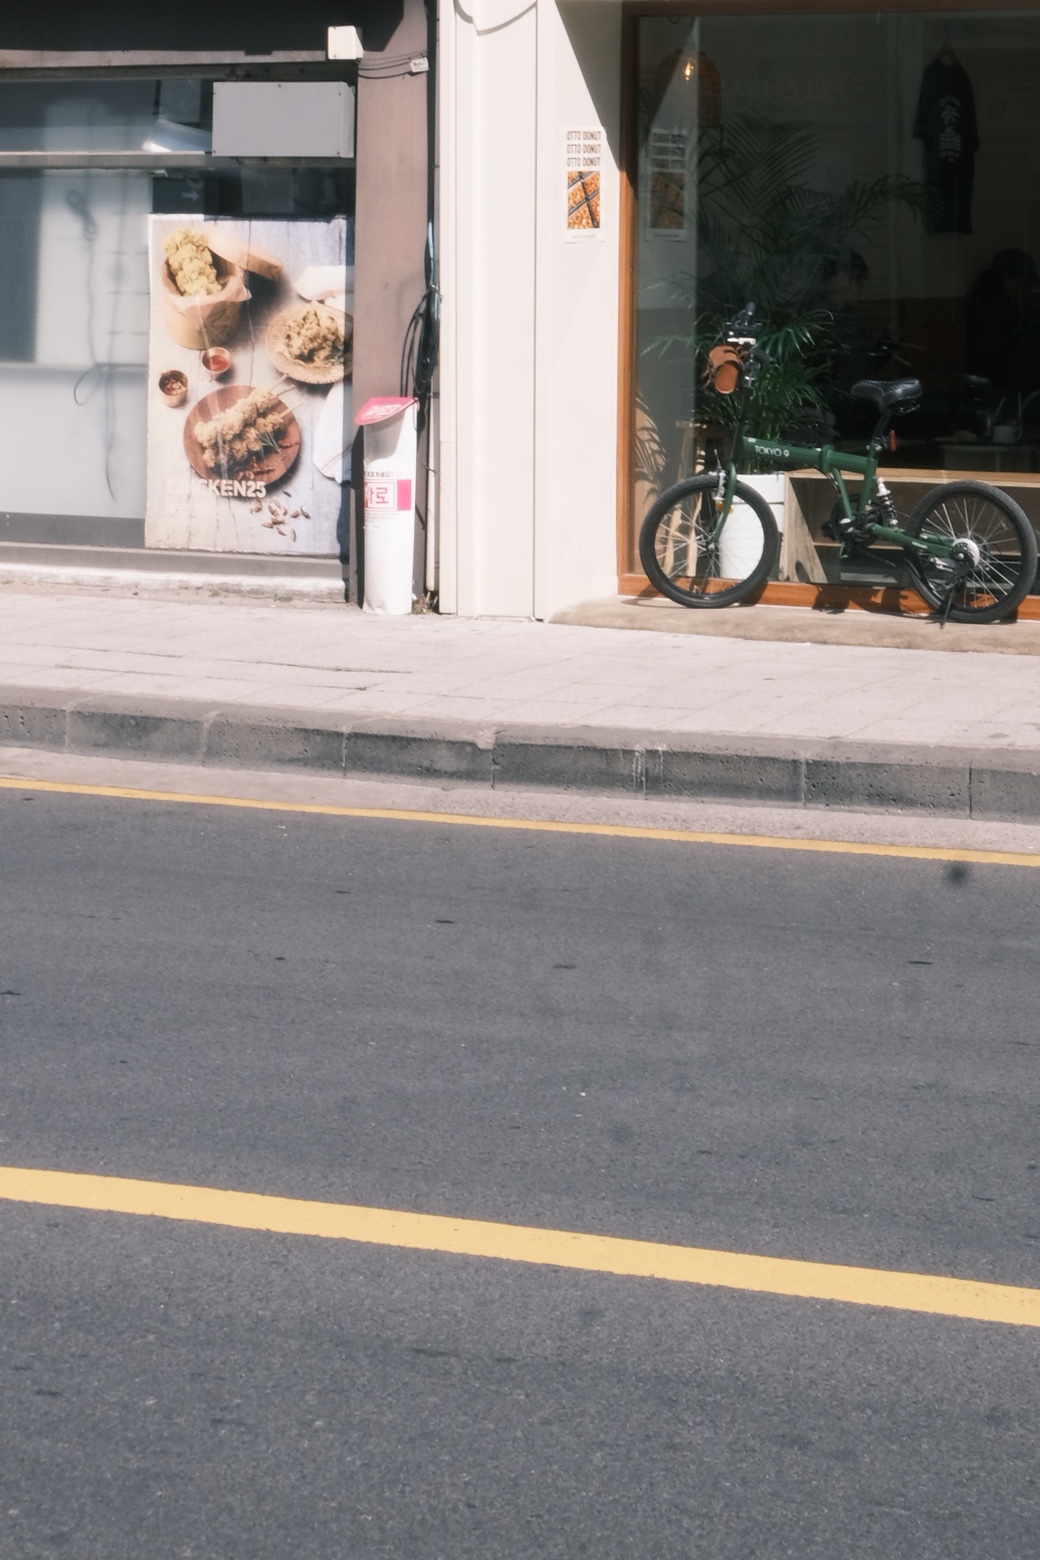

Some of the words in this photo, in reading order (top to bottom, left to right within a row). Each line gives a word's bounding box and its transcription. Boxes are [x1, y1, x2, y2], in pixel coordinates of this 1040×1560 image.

[567, 130, 581, 141] OTTO
[583, 130, 601, 141] DONUT
[567, 143, 581, 154] OTTO
[583, 143, 601, 154] DONUT
[567, 157, 581, 168] OTTO
[583, 157, 601, 168] DONUT
[754, 445, 782, 457] TOKYO
[783, 449, 790, 458] 9
[166, 478, 267, 498] CKEN25
